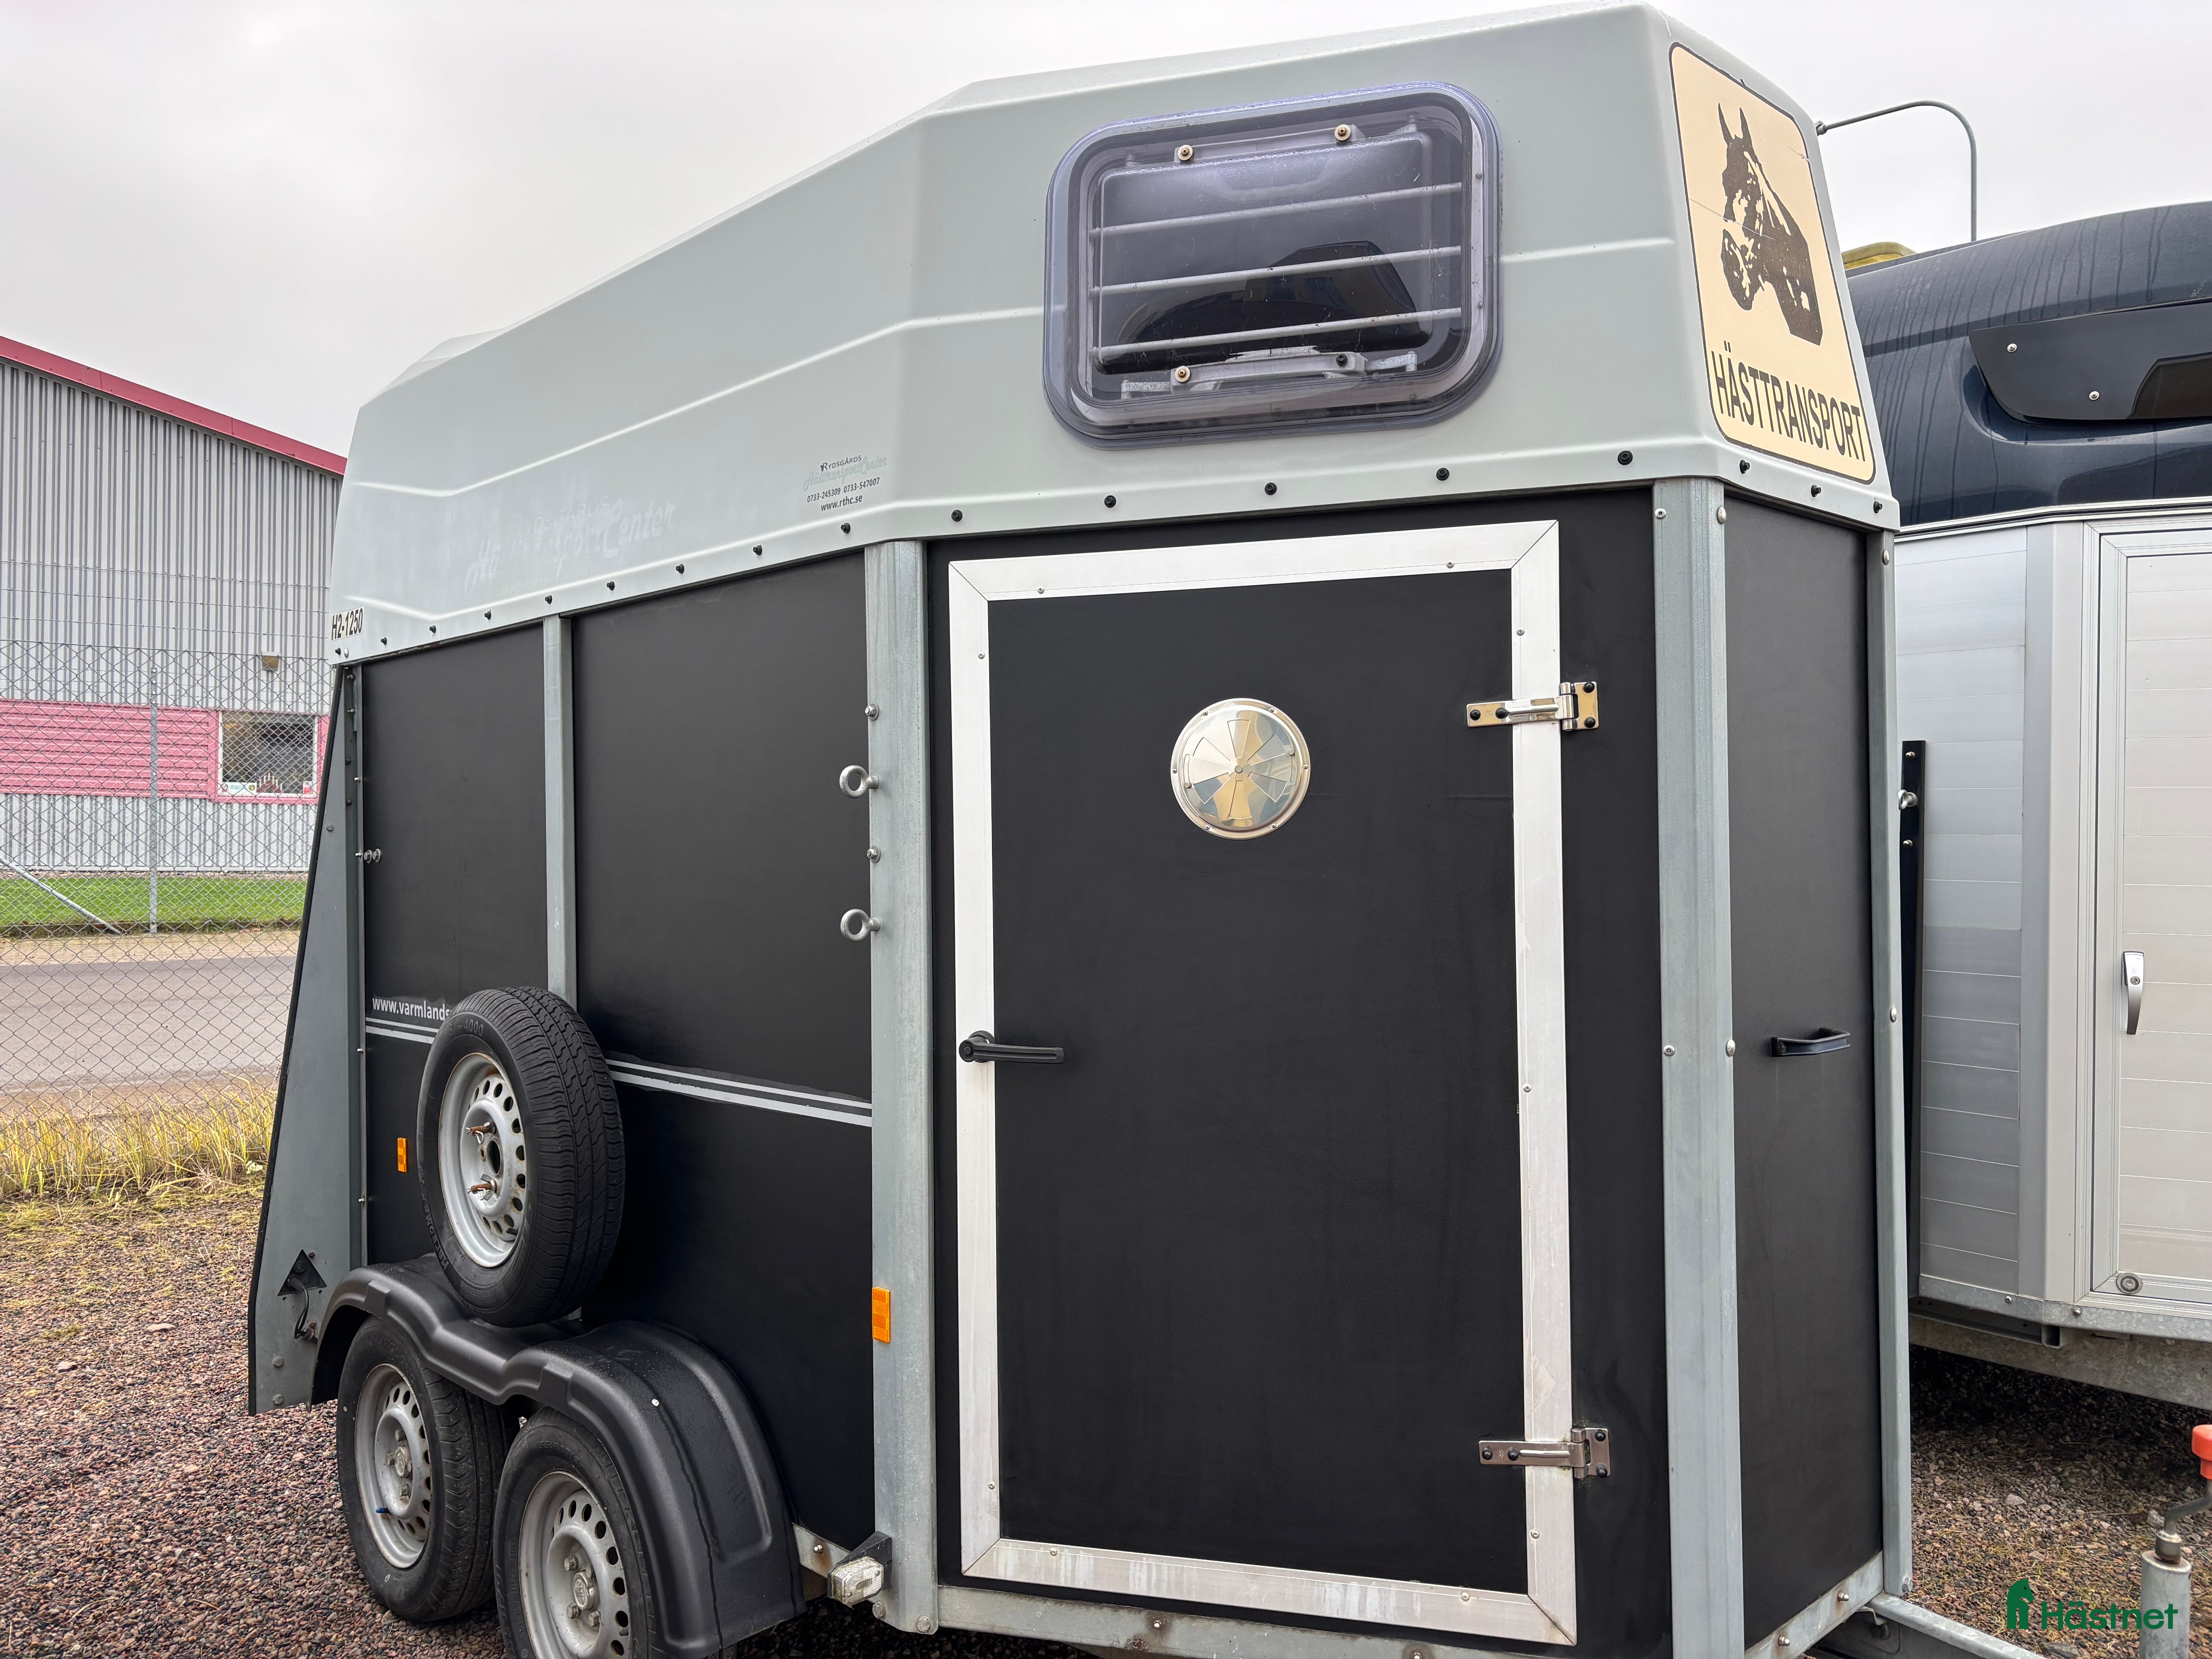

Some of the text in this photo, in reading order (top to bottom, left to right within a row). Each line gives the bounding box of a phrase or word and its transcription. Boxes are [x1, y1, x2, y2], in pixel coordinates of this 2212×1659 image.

[1711, 340, 1865, 462] HÄSTTRANSPORT
[821, 455, 862, 471] RYDSGÅRDS
[807, 477, 880, 503] 0733-245309 0733-547007
[821, 495, 862, 511] www.rthc.se
[331, 608, 363, 640] H2-1250
[372, 998, 452, 1021] www.varmlands
